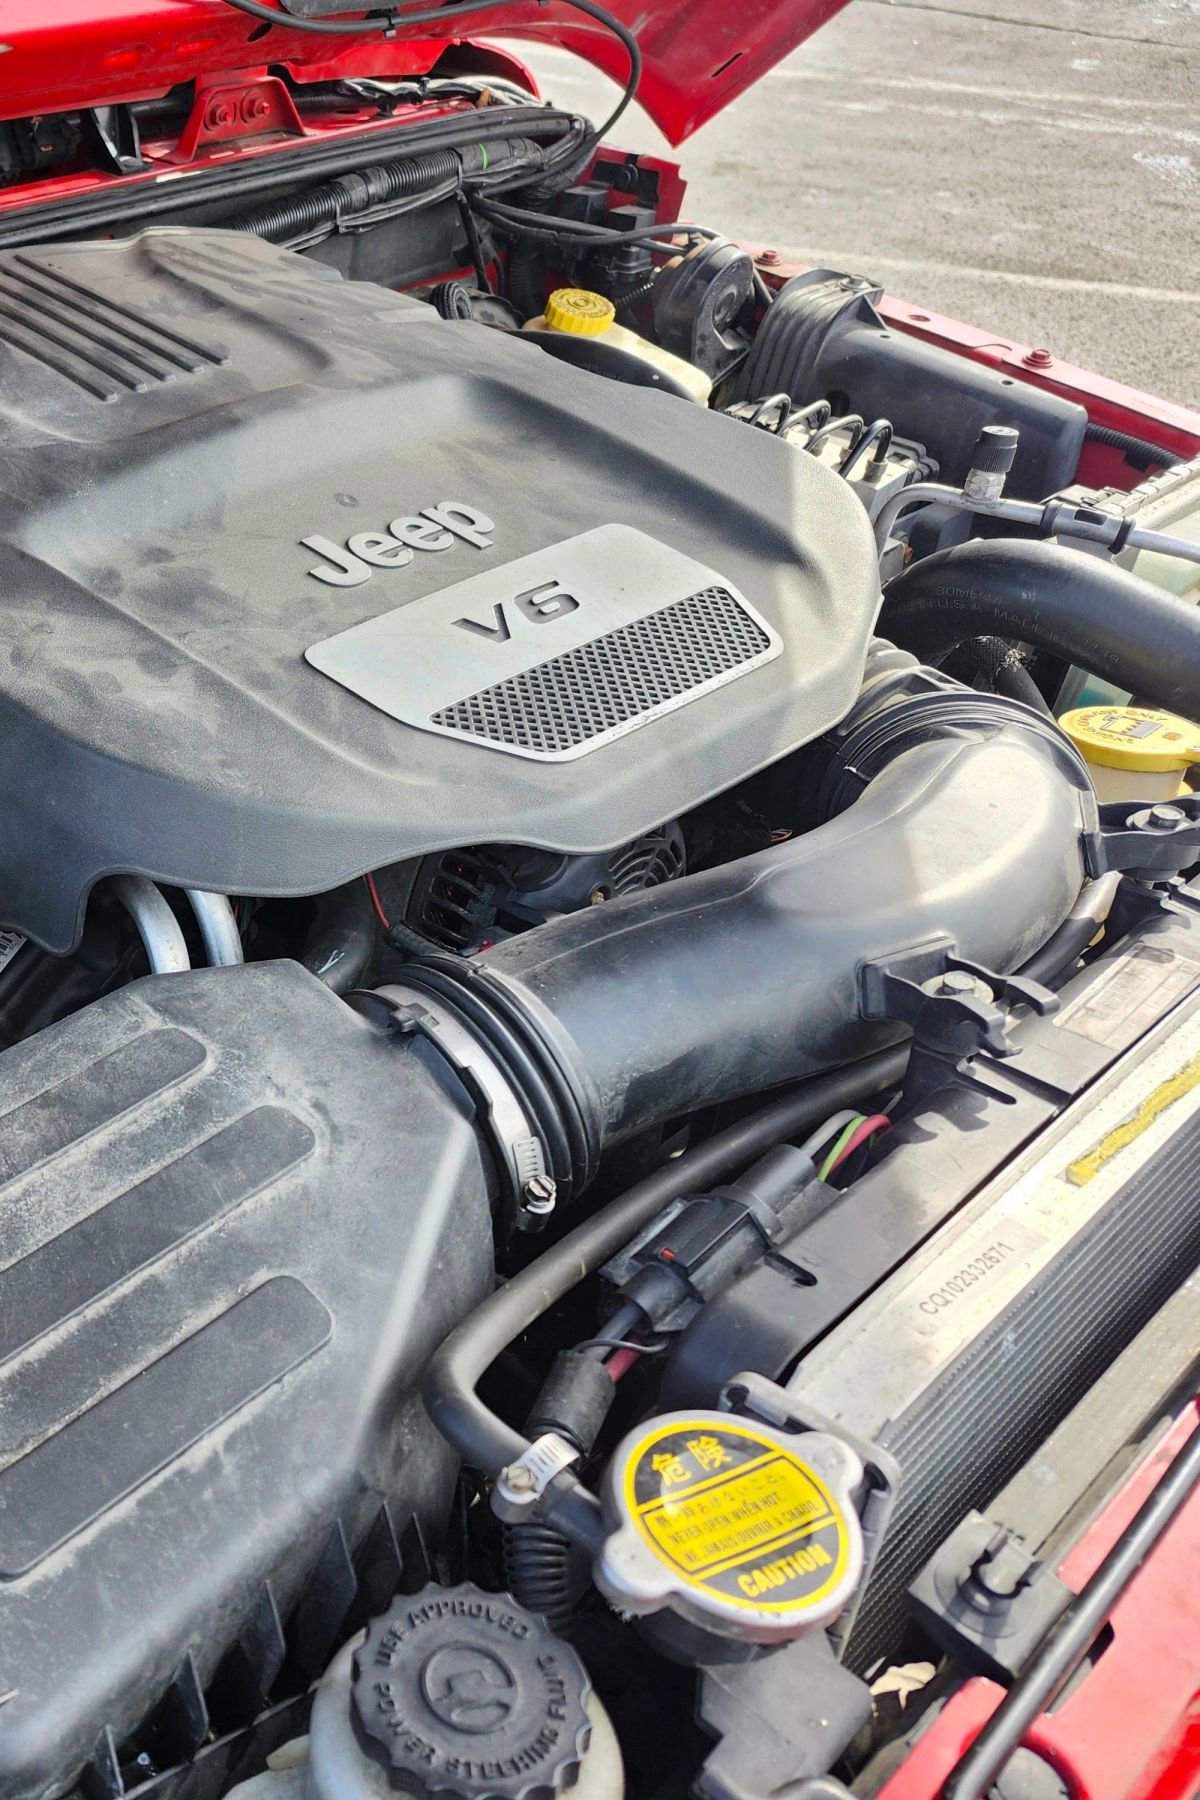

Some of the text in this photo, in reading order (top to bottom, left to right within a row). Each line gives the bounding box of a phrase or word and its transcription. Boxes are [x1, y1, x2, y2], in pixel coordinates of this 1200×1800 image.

[299, 500, 495, 587] Jeep
[451, 580, 581, 643] V6
[920, 1240, 1016, 1316] CQ102332671
[651, 1435, 734, 1486] 危険
[669, 1523, 703, 1546] NEVER
[704, 1515, 732, 1535] OPEN
[732, 1502, 764, 1524] WHEN
[737, 1543, 832, 1598] CAUTION
[410, 1599, 531, 1641] APPROVED
[374, 1654, 568, 1780] POWER STEERING FLUID
